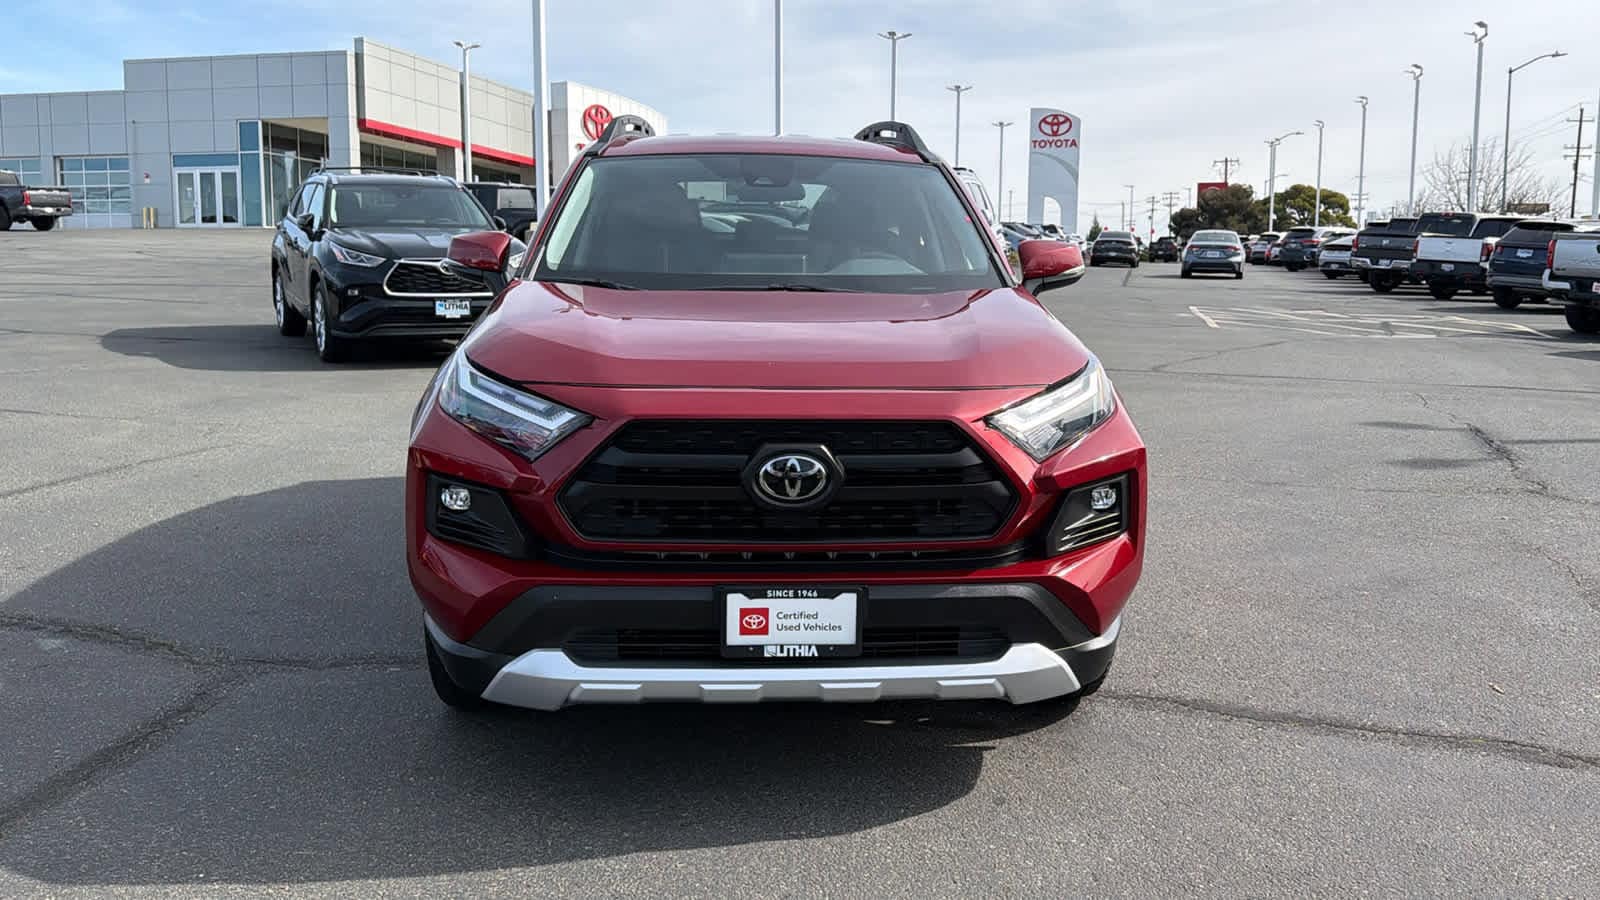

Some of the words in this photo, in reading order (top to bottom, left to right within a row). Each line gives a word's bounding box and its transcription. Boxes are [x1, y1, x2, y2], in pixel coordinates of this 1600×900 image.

[1032, 139, 1077, 149] TOYOTA
[444, 303, 469, 311] LITHIA
[766, 589, 794, 598] SINCE
[797, 589, 818, 598] 1946
[776, 611, 818, 620] Certified
[776, 623, 801, 632] Used
[803, 623, 842, 632] Vehicles
[777, 645, 818, 657] LITHIA
